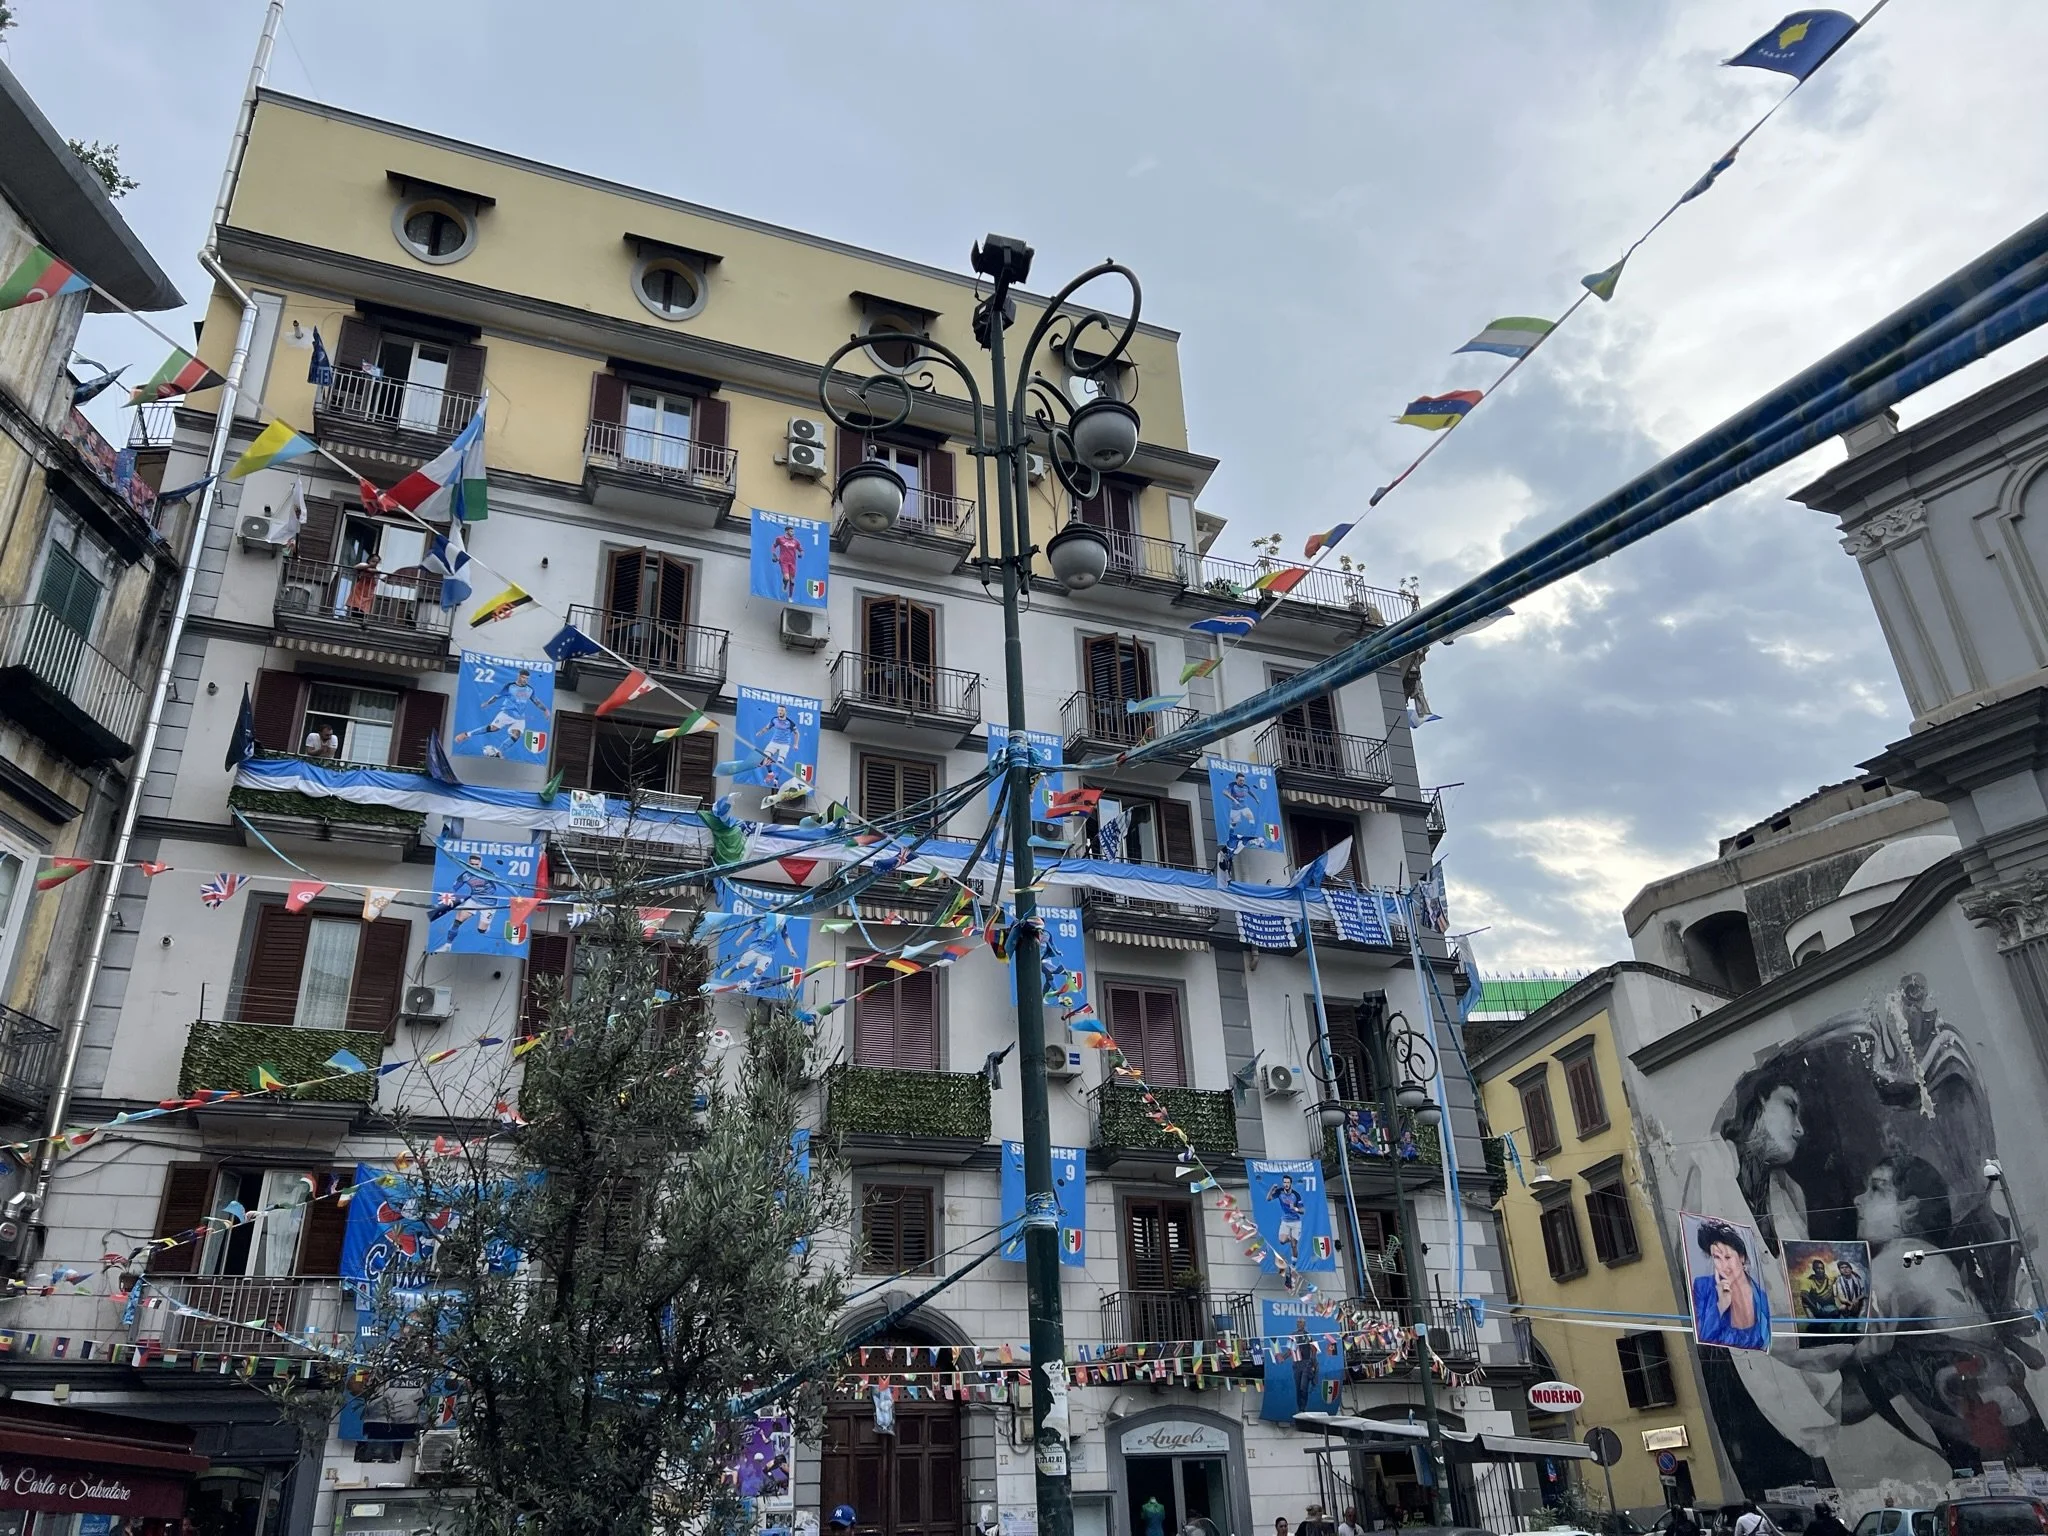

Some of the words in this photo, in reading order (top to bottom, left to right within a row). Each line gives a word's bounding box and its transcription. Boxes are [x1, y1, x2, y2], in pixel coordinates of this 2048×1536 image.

[760, 512, 822, 531] MERET
[812, 533, 819, 545] 1
[813, 584, 819, 592] 3
[485, 656, 553, 674] LORENZO
[474, 667, 495, 683] 22
[798, 711, 814, 726] 13
[532, 736, 539, 745] 3
[1044, 748, 1052, 760] 3
[801, 768, 806, 776] 3
[1210, 759, 1249, 774] MARIO
[1251, 765, 1272, 776] RUI
[1259, 778, 1267, 790] 6
[508, 861, 530, 877] 20
[512, 927, 519, 936] 3
[1059, 923, 1077, 938] 99
[1065, 1164, 1076, 1181] 9
[1303, 1176, 1317, 1192] 77
[1069, 1235, 1075, 1244] 3
[1319, 1242, 1325, 1250] 3
[1328, 1386, 1333, 1395] 3
[1531, 1389, 1582, 1404] MORENO
[1137, 1426, 1205, 1449] Angels
[14, 1467, 55, 1495] Carla
[58, 1482, 67, 1496] e
[69, 1472, 131, 1500] Salvatore
